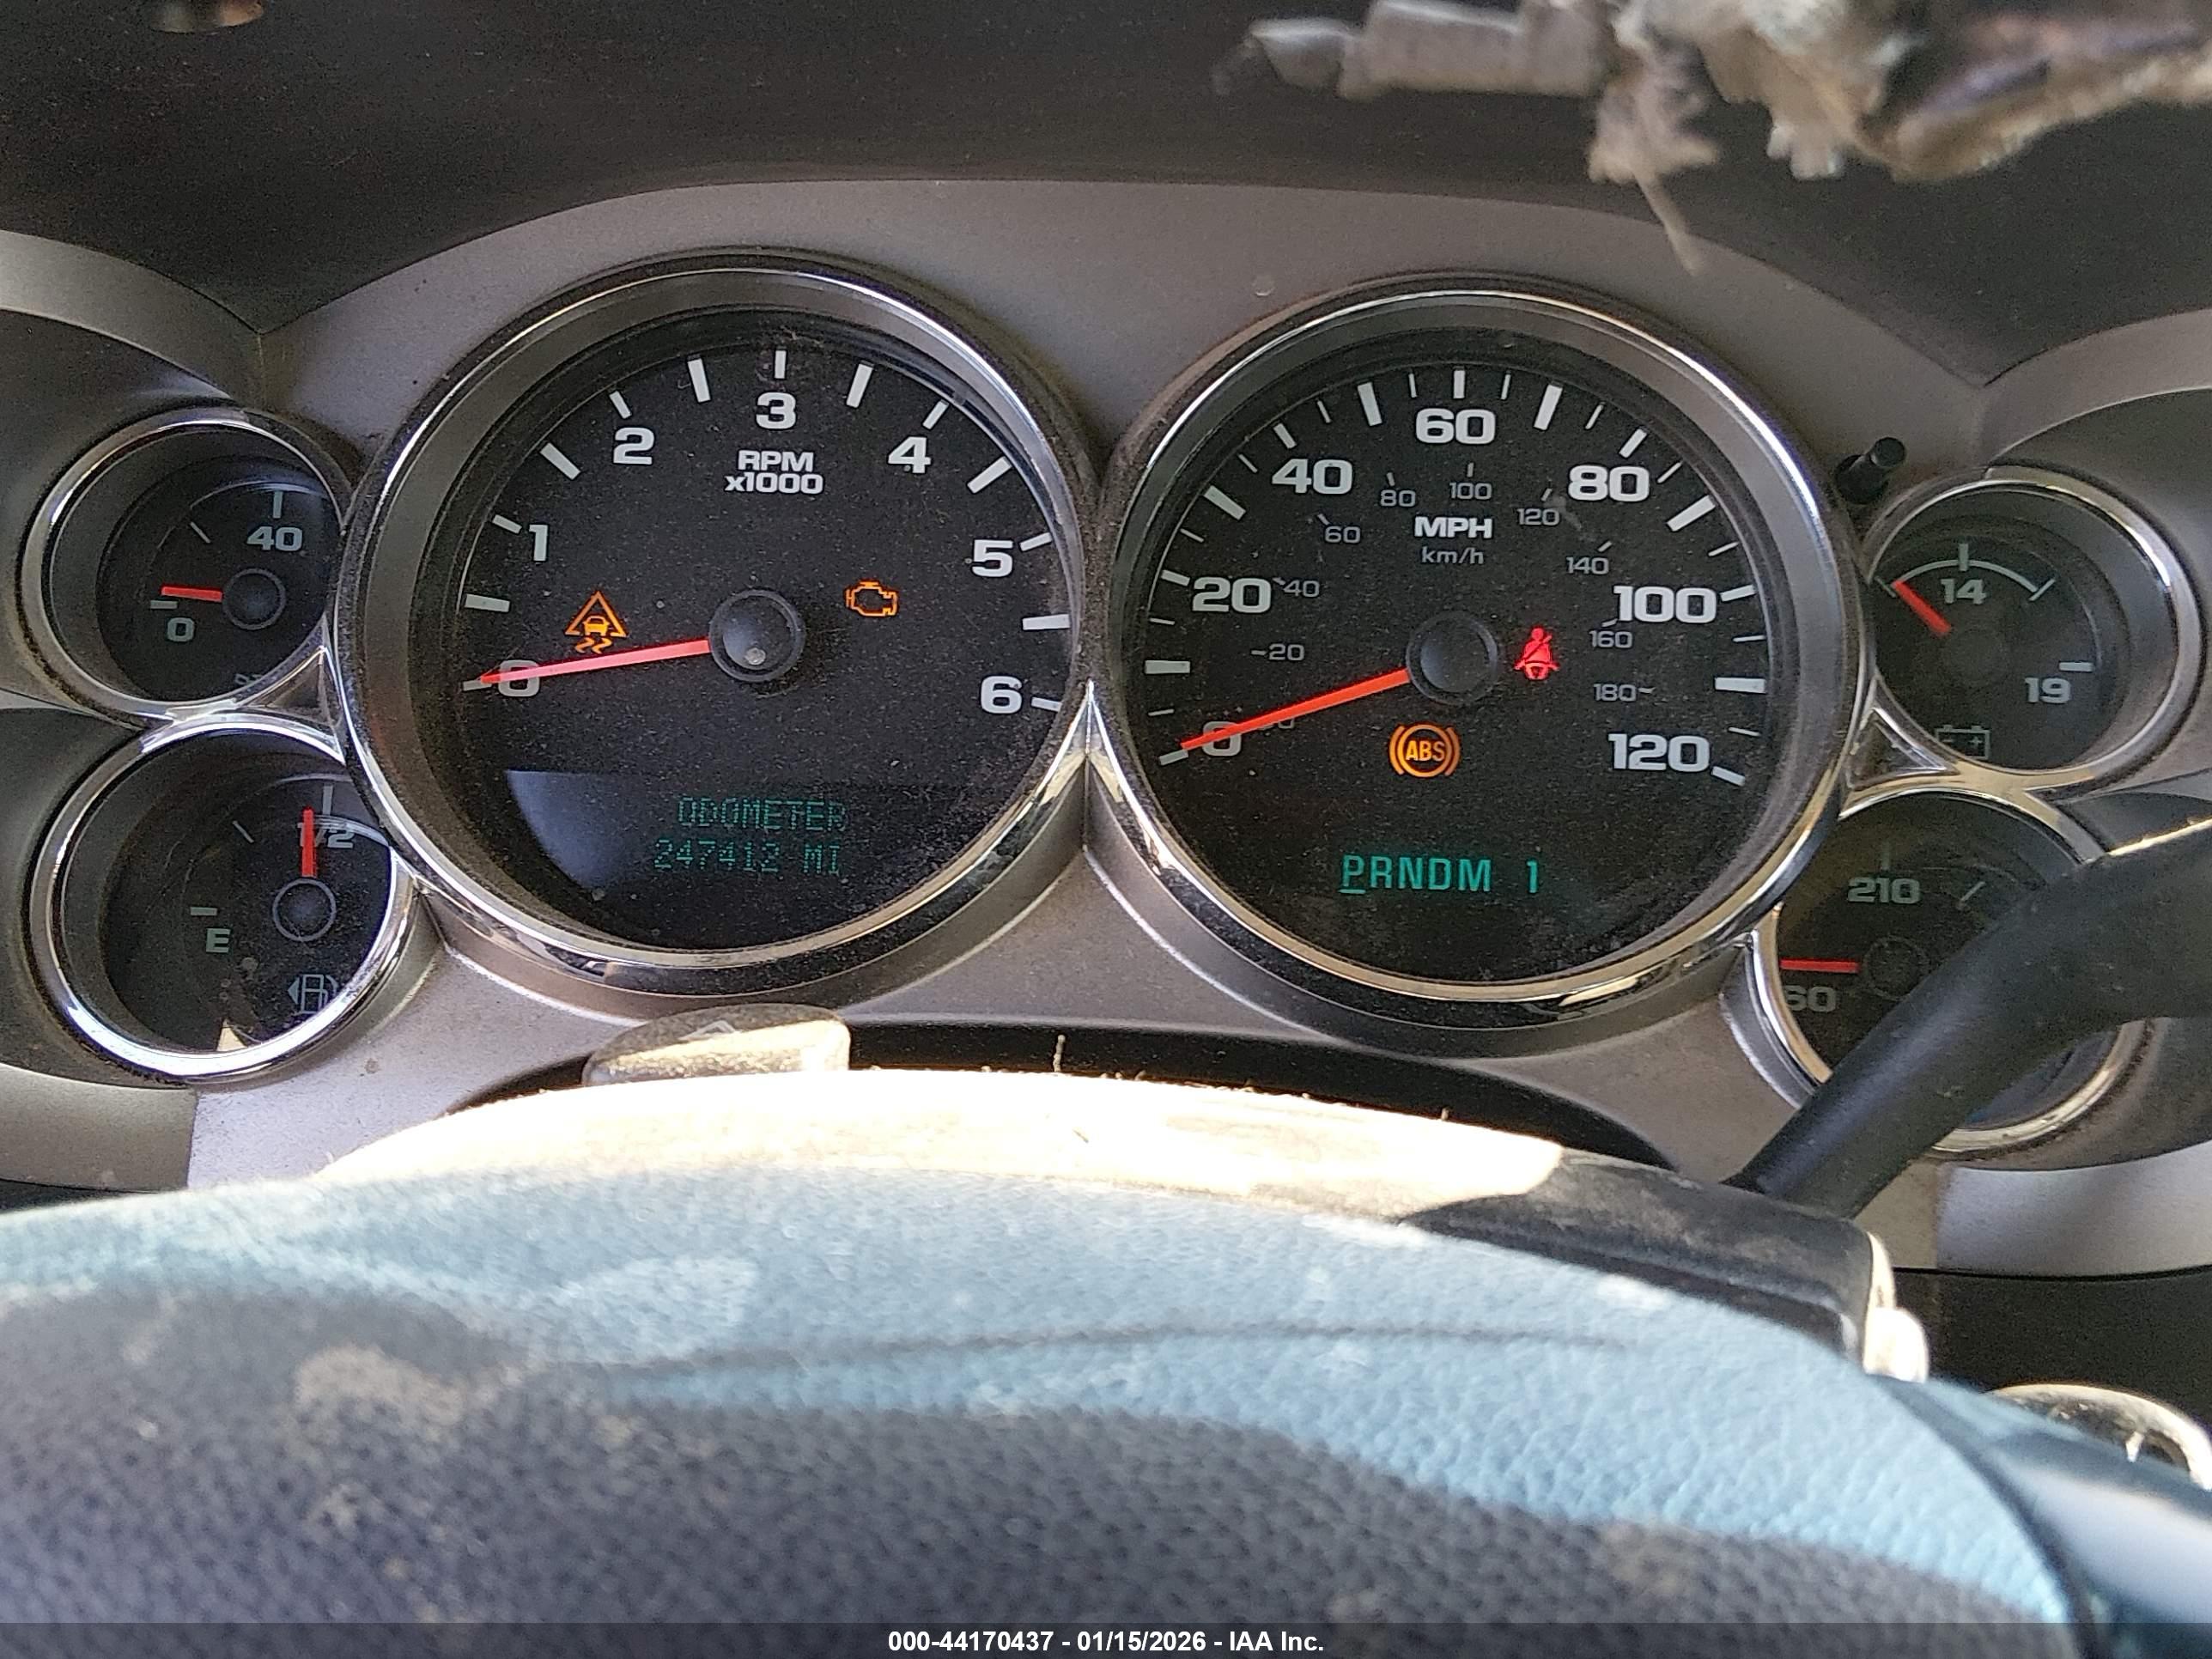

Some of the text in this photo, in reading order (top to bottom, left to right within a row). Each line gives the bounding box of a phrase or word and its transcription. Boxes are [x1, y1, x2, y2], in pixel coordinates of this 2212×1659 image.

[757, 392, 796, 428] 3
[1416, 409, 1495, 444] 60
[613, 428, 654, 465] 2
[888, 436, 932, 473] 4
[738, 450, 814, 471] RPM
[725, 472, 823, 494] x1000
[1273, 459, 1352, 494] 40
[1568, 465, 1650, 501] 80
[1380, 489, 1416, 507] 80
[1449, 482, 1492, 500] 100
[1414, 516, 1492, 538] MPH
[1516, 507, 1559, 526] 120
[246, 526, 303, 551] 40
[529, 525, 548, 562] 1
[1325, 526, 1361, 544] 60
[972, 539, 1013, 577] 5
[1422, 545, 1484, 564] km/h
[1566, 556, 1609, 574] 140
[1192, 577, 1271, 612] 20
[1284, 580, 1320, 598] 40
[1941, 579, 1987, 605] 14
[1614, 586, 1716, 623] 100
[167, 617, 195, 642] 0
[1590, 630, 1632, 648] 160
[1269, 643, 1305, 661] 20
[497, 660, 541, 697] 0
[2024, 678, 2071, 703] 19
[981, 676, 1022, 714] 6
[1594, 684, 1637, 702] 180
[1405, 739, 1445, 762] ABS
[1608, 733, 1710, 771] 120
[678, 797, 847, 831] ODOMETER
[654, 839, 839, 875] 247412 MI
[1847, 878, 1920, 904] 210
[205, 927, 230, 953] E
